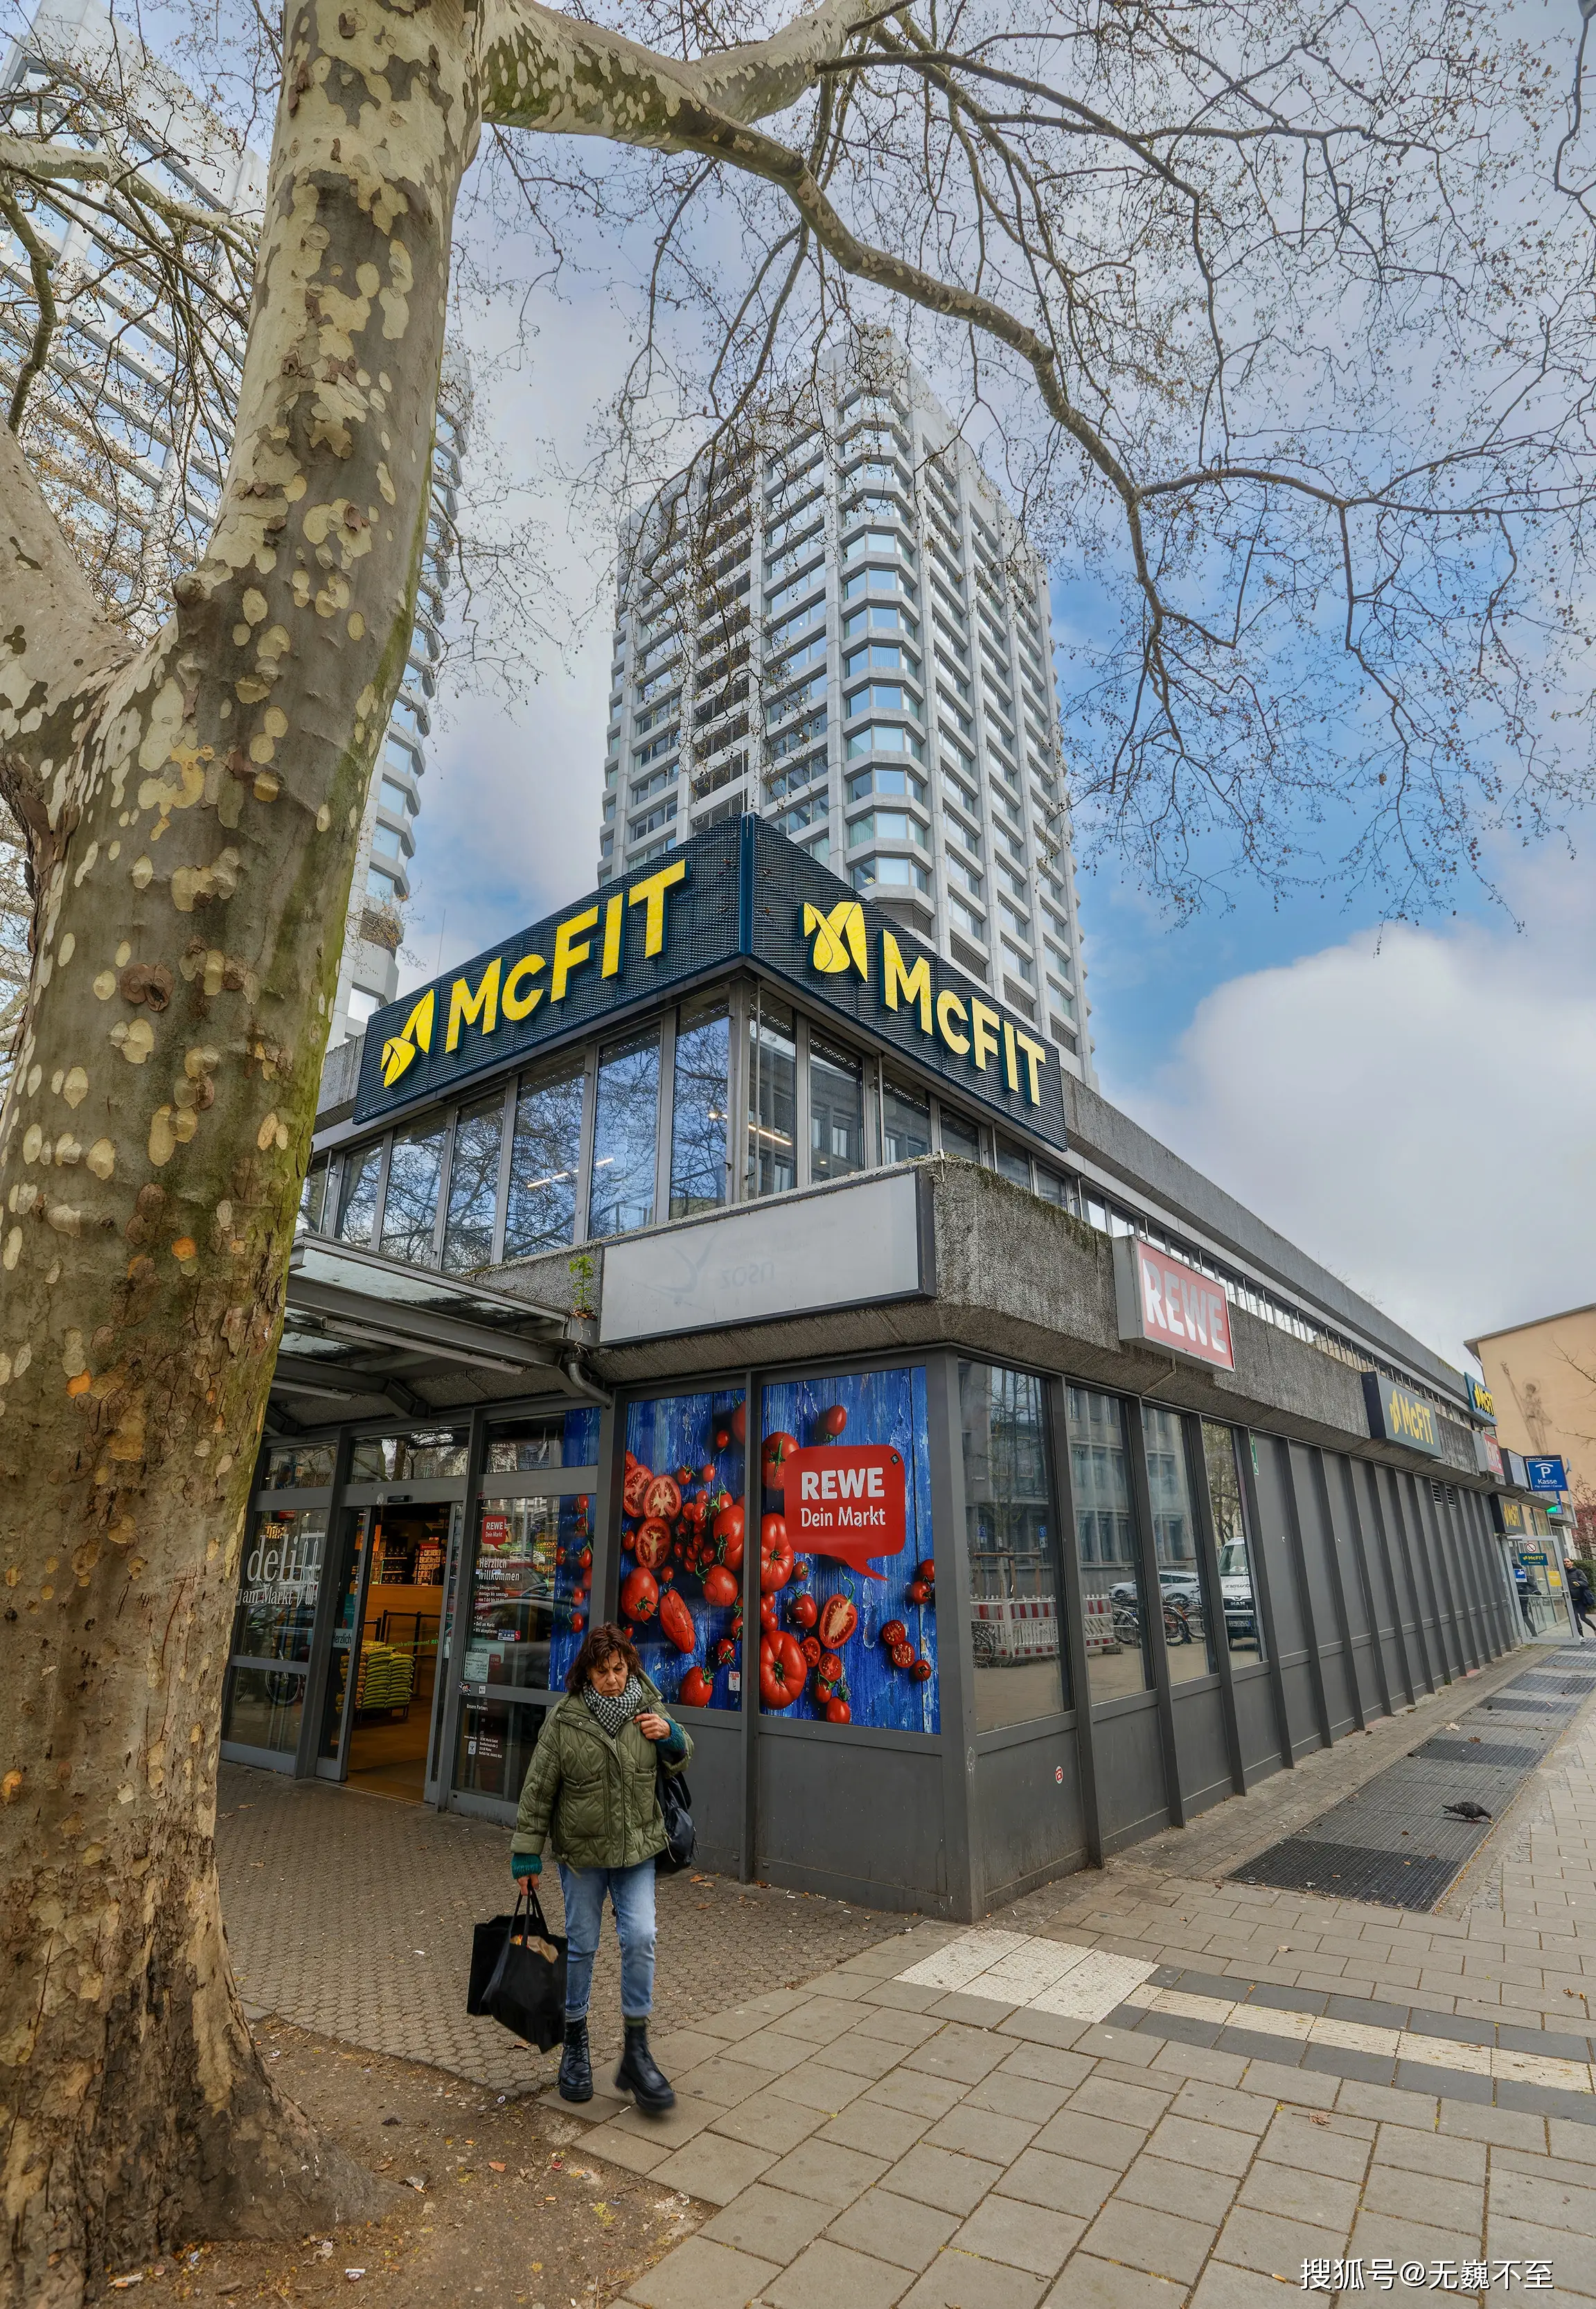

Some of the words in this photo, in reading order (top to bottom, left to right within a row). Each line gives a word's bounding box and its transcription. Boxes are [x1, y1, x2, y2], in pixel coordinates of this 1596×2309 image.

[445, 859, 689, 1054] McFIT
[878, 928, 1046, 1106] McFIT
[1143, 1258, 1227, 1354] REWE
[1399, 1394, 1434, 1445] McFIT
[801, 1467, 885, 1501] REWE
[1541, 1466, 1551, 1478] P
[486, 1521, 504, 1530] REWE
[801, 1507, 833, 1528] Dein
[837, 1505, 886, 1527] Markt
[247, 1534, 299, 1582] deli
[479, 1557, 507, 1568] Herzlich
[478, 1570, 520, 1581] willkommen
[242, 1589, 258, 1604] am
[262, 1586, 294, 1605] Markt
